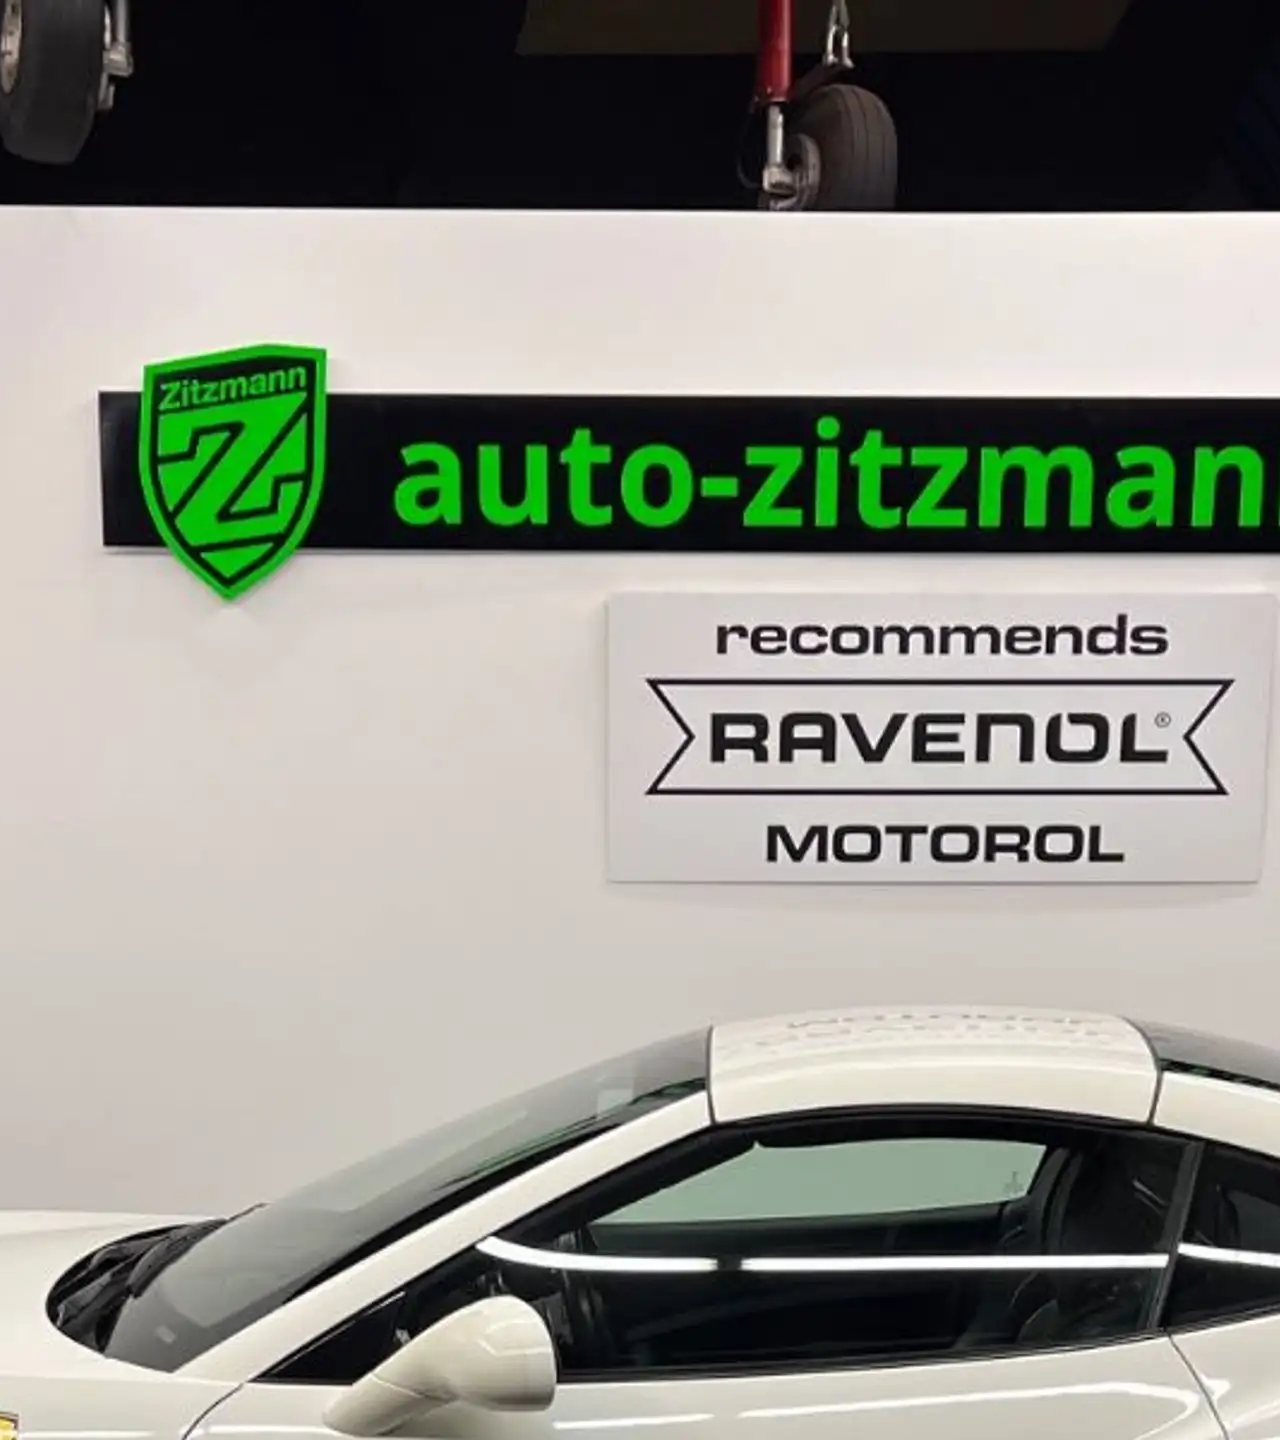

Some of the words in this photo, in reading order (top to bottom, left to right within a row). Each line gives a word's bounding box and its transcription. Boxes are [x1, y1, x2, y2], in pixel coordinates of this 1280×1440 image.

[158, 366, 307, 411] Zitzmann
[716, 613, 1169, 656] recommends
[766, 824, 1125, 863] MOTOROL
